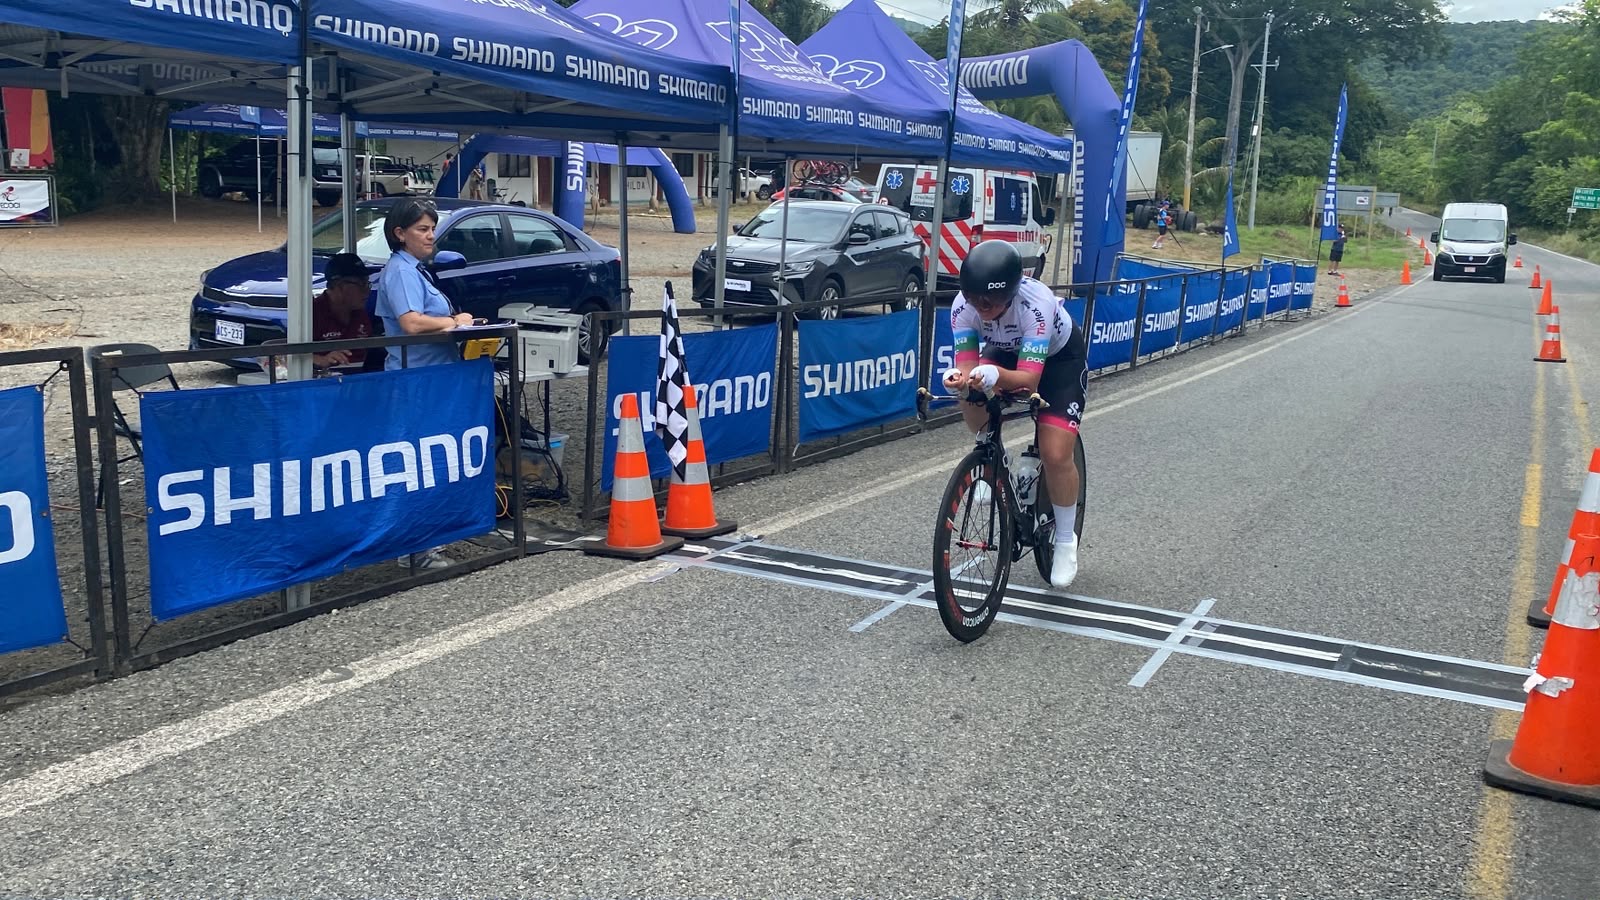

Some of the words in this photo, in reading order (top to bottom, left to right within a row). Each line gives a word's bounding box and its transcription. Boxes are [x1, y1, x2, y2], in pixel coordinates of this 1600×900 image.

[452, 37, 556, 73] SHIMANO
[565, 54, 650, 90] SHIMANO
[658, 74, 727, 105] SHIMANO
[743, 97, 801, 120] SHIMANO
[806, 105, 854, 126] SHIMANO
[858, 112, 902, 134] SHIMANO
[905, 121, 943, 140] SHIMANO
[954, 131, 986, 149] SHIMANO
[988, 138, 1016, 153] SHIMANO
[1073, 140, 1085, 265] SHIMANO
[1093, 317, 1137, 343] SHIMAN
[803, 348, 916, 399] SHIMANO
[157, 425, 489, 536] SHIMANO
